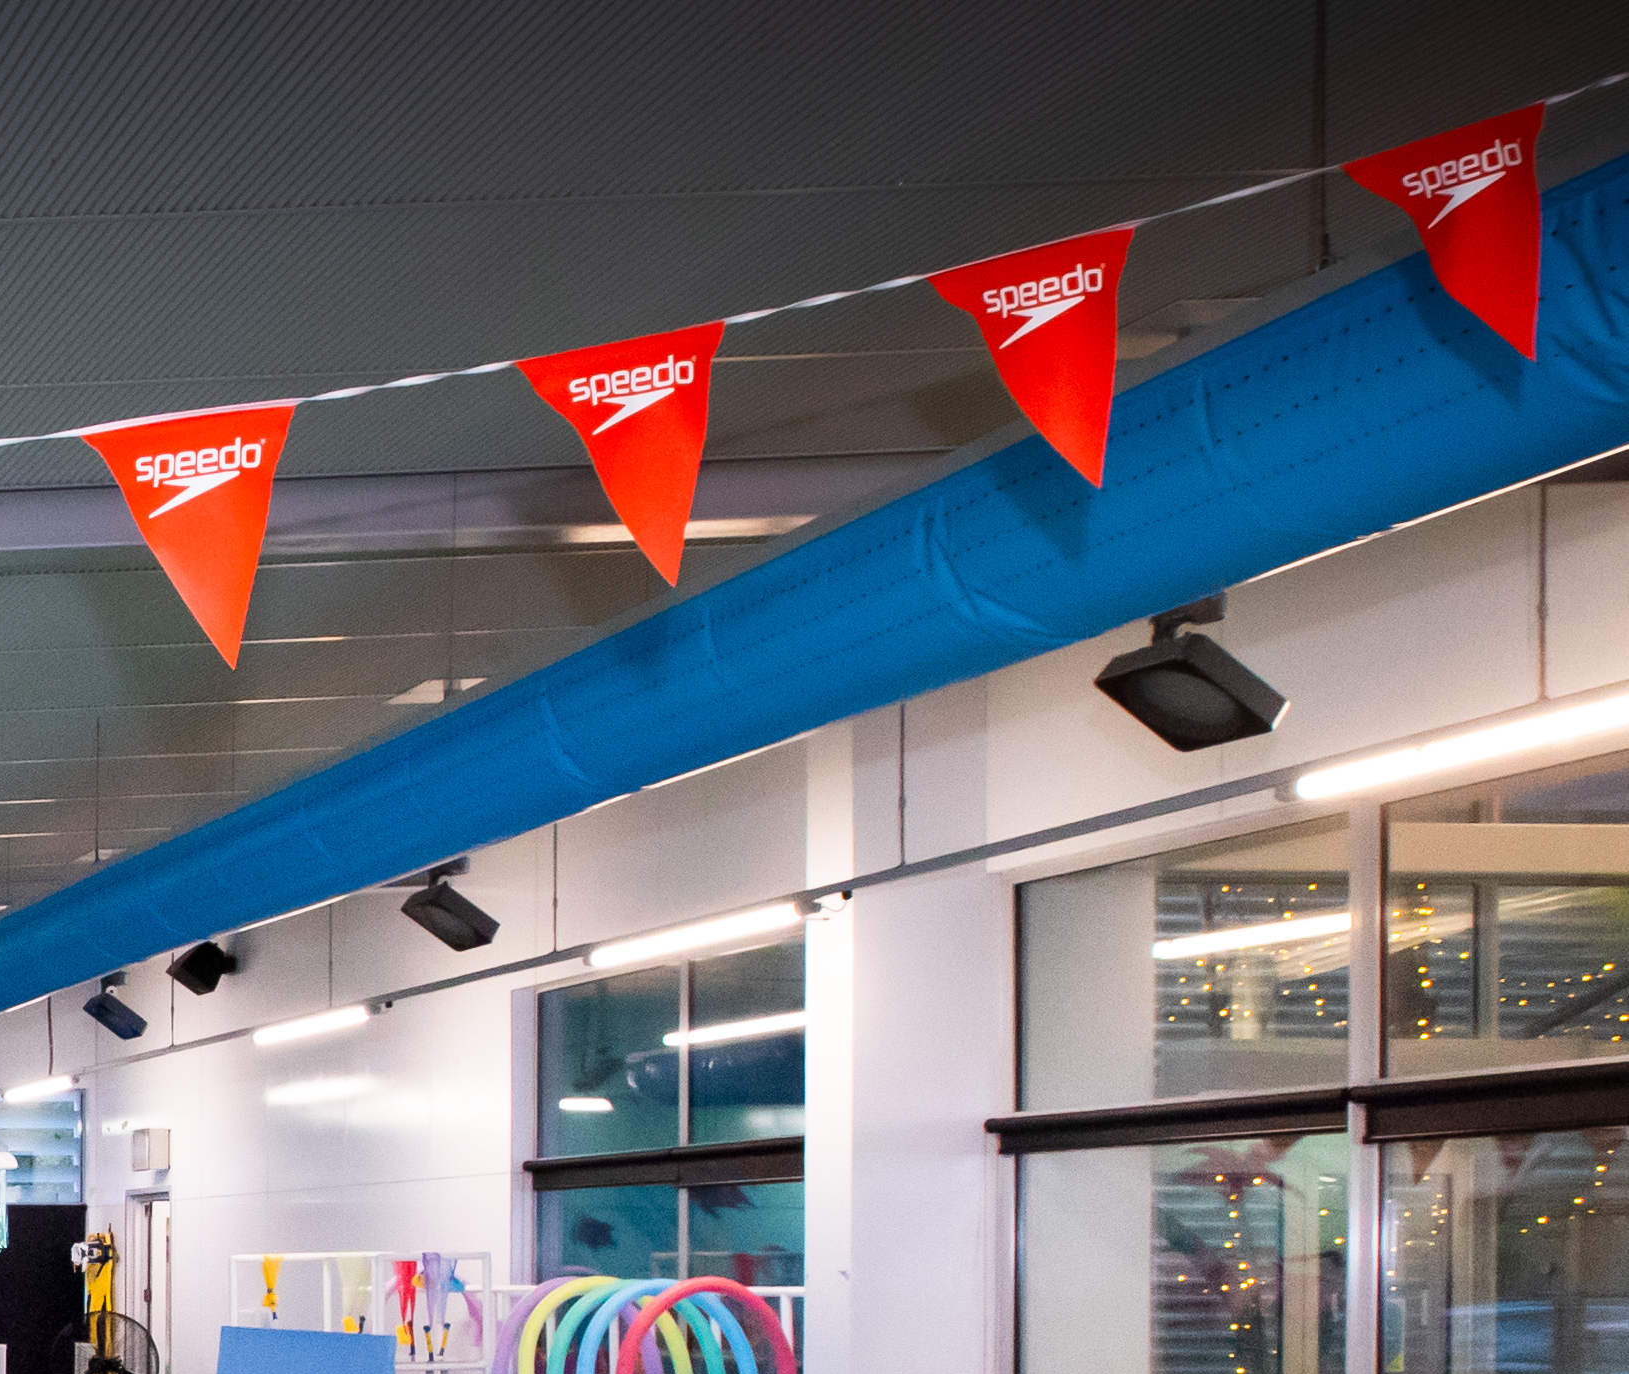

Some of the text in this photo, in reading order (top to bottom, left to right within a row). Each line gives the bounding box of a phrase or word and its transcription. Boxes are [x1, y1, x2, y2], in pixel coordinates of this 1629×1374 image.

[1402, 139, 1522, 198] speedo
[982, 264, 1103, 317] speedo
[569, 355, 695, 405] speedo
[135, 437, 261, 487] speedo
